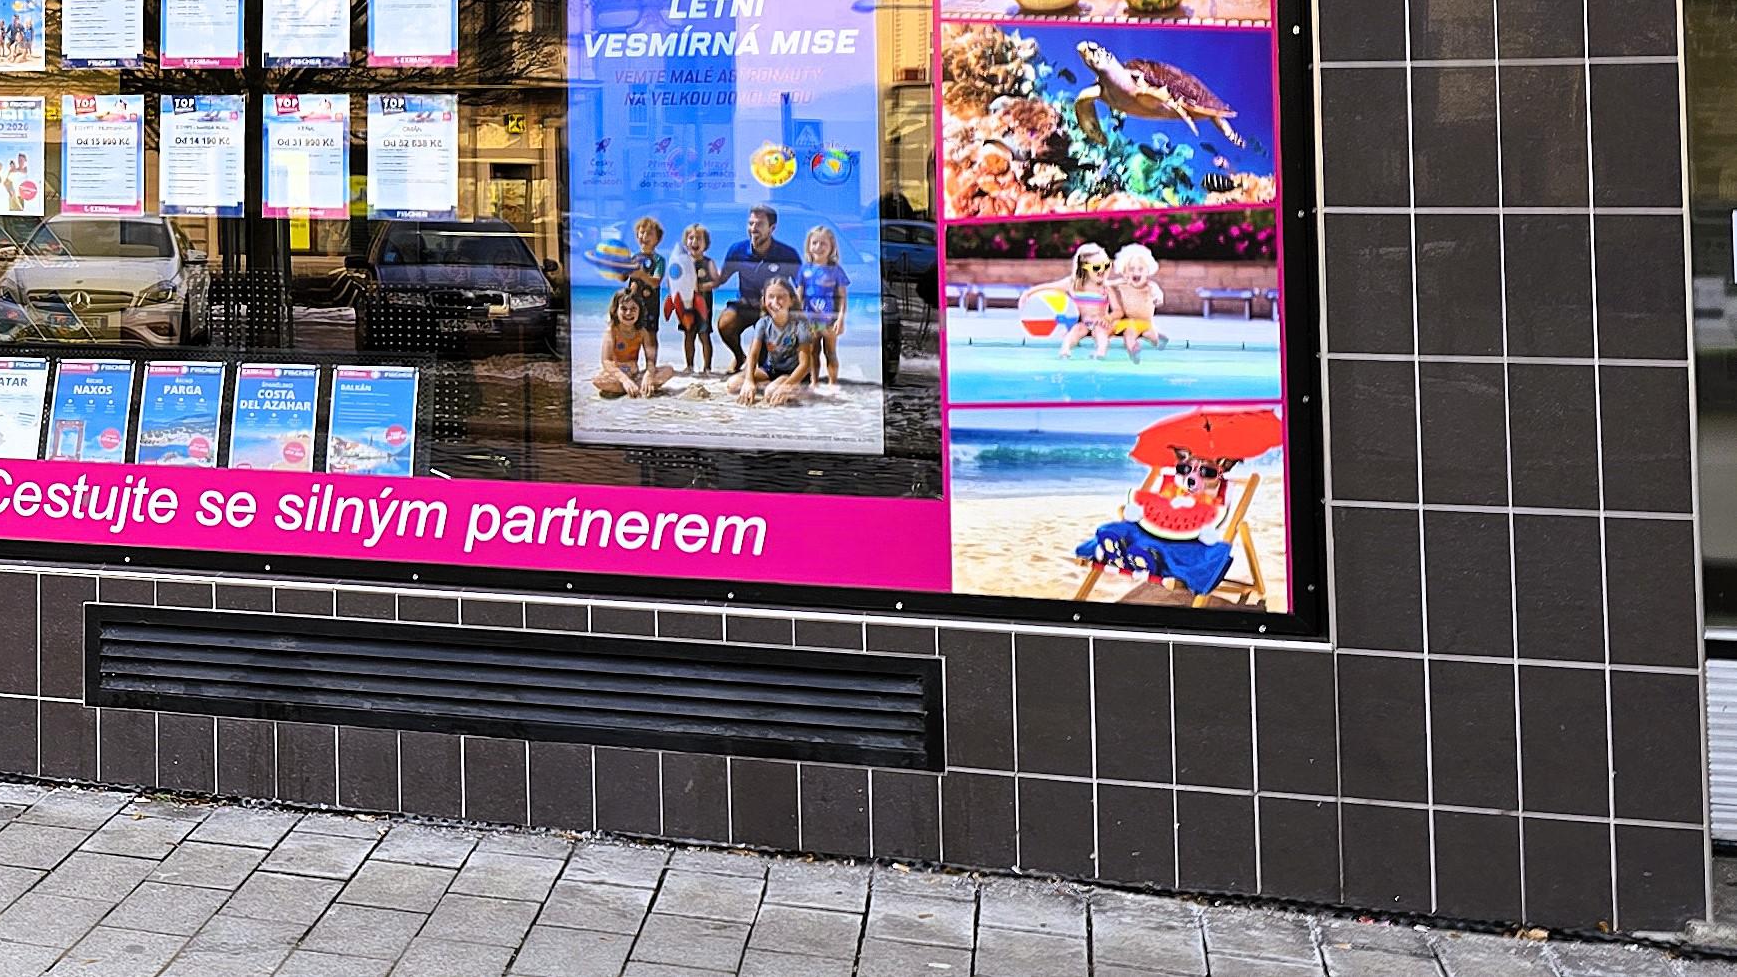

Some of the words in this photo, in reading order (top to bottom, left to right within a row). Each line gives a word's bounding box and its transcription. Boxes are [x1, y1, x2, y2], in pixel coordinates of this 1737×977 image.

[583, 24, 761, 58] VESMÍRNÁ
[770, 28, 860, 55] MISE
[669, 66, 713, 84] MALÉ
[76, 99, 96, 109] TOP
[174, 98, 195, 108] TOP
[277, 98, 298, 109] TOP
[383, 97, 405, 109] TOP
[651, 91, 712, 106] VELKOU
[119, 137, 130, 145] Kč
[175, 137, 188, 145] Od
[189, 137, 200, 145] 14
[219, 137, 231, 145] Kč
[277, 138, 290, 146] Od
[323, 137, 335, 146] Kč
[383, 139, 396, 147] Od
[430, 139, 443, 147] Kč
[73, 384, 113, 395] NAXOS
[163, 385, 202, 395] PARGA
[257, 389, 296, 400] COSTA
[239, 399, 261, 410] DEL
[262, 400, 312, 411] AZAHAR
[195, 489, 258, 528] se
[274, 484, 448, 548] silným
[465, 500, 768, 557] partnerem
